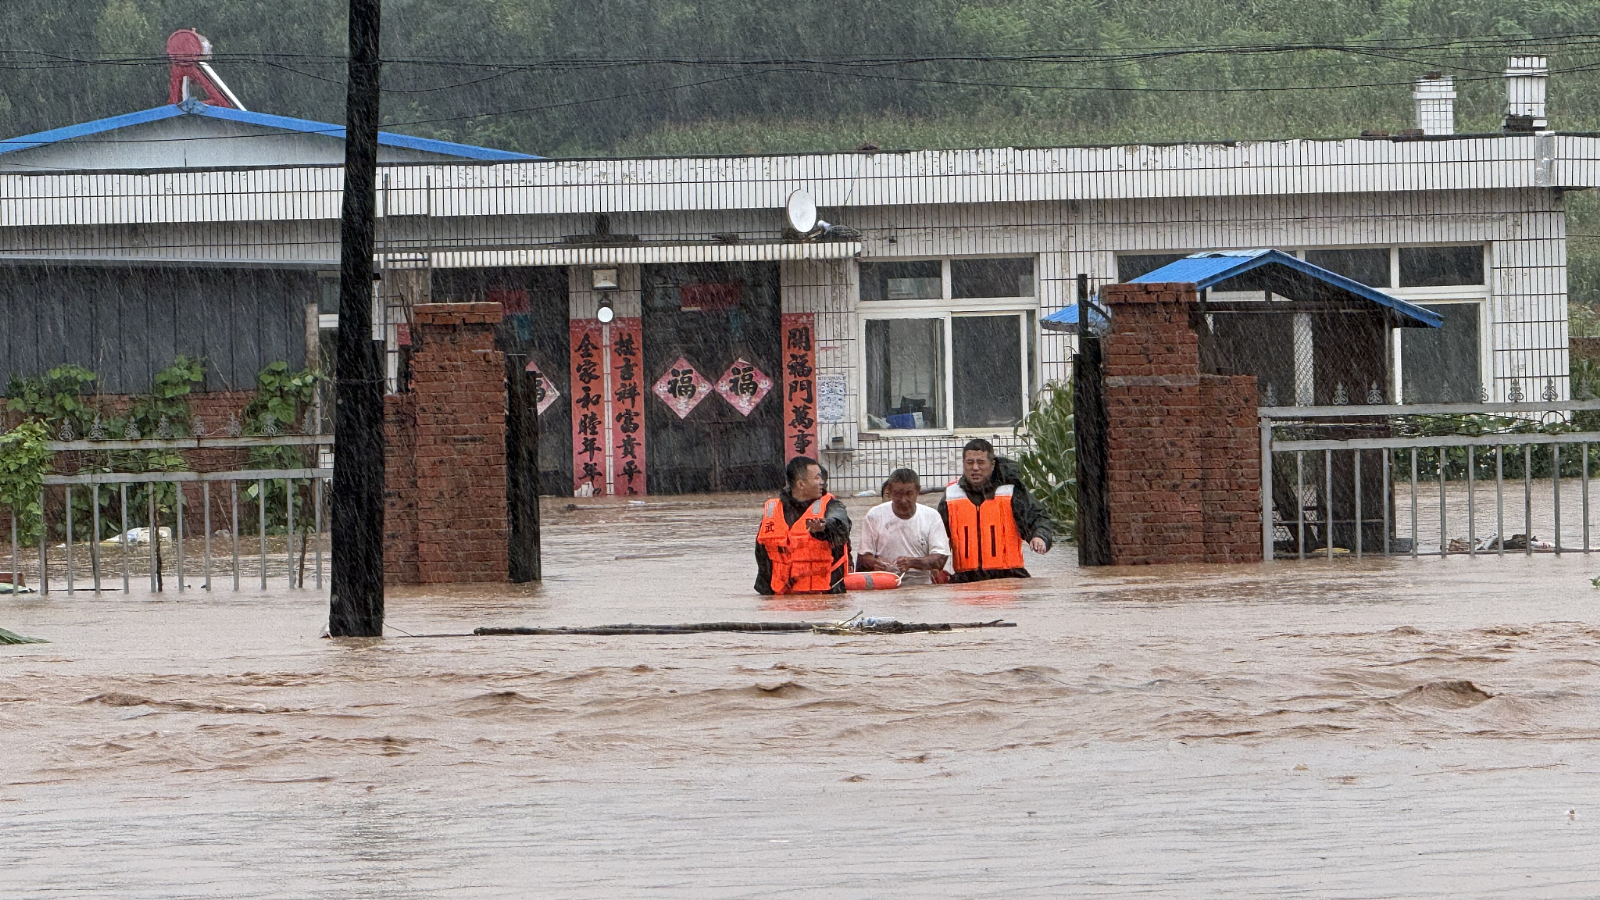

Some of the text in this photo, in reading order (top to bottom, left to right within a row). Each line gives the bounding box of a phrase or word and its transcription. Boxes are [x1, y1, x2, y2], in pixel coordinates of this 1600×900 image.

[667, 368, 697, 399] 福
[728, 366, 758, 397] 福
[764, 520, 775, 534] 武
